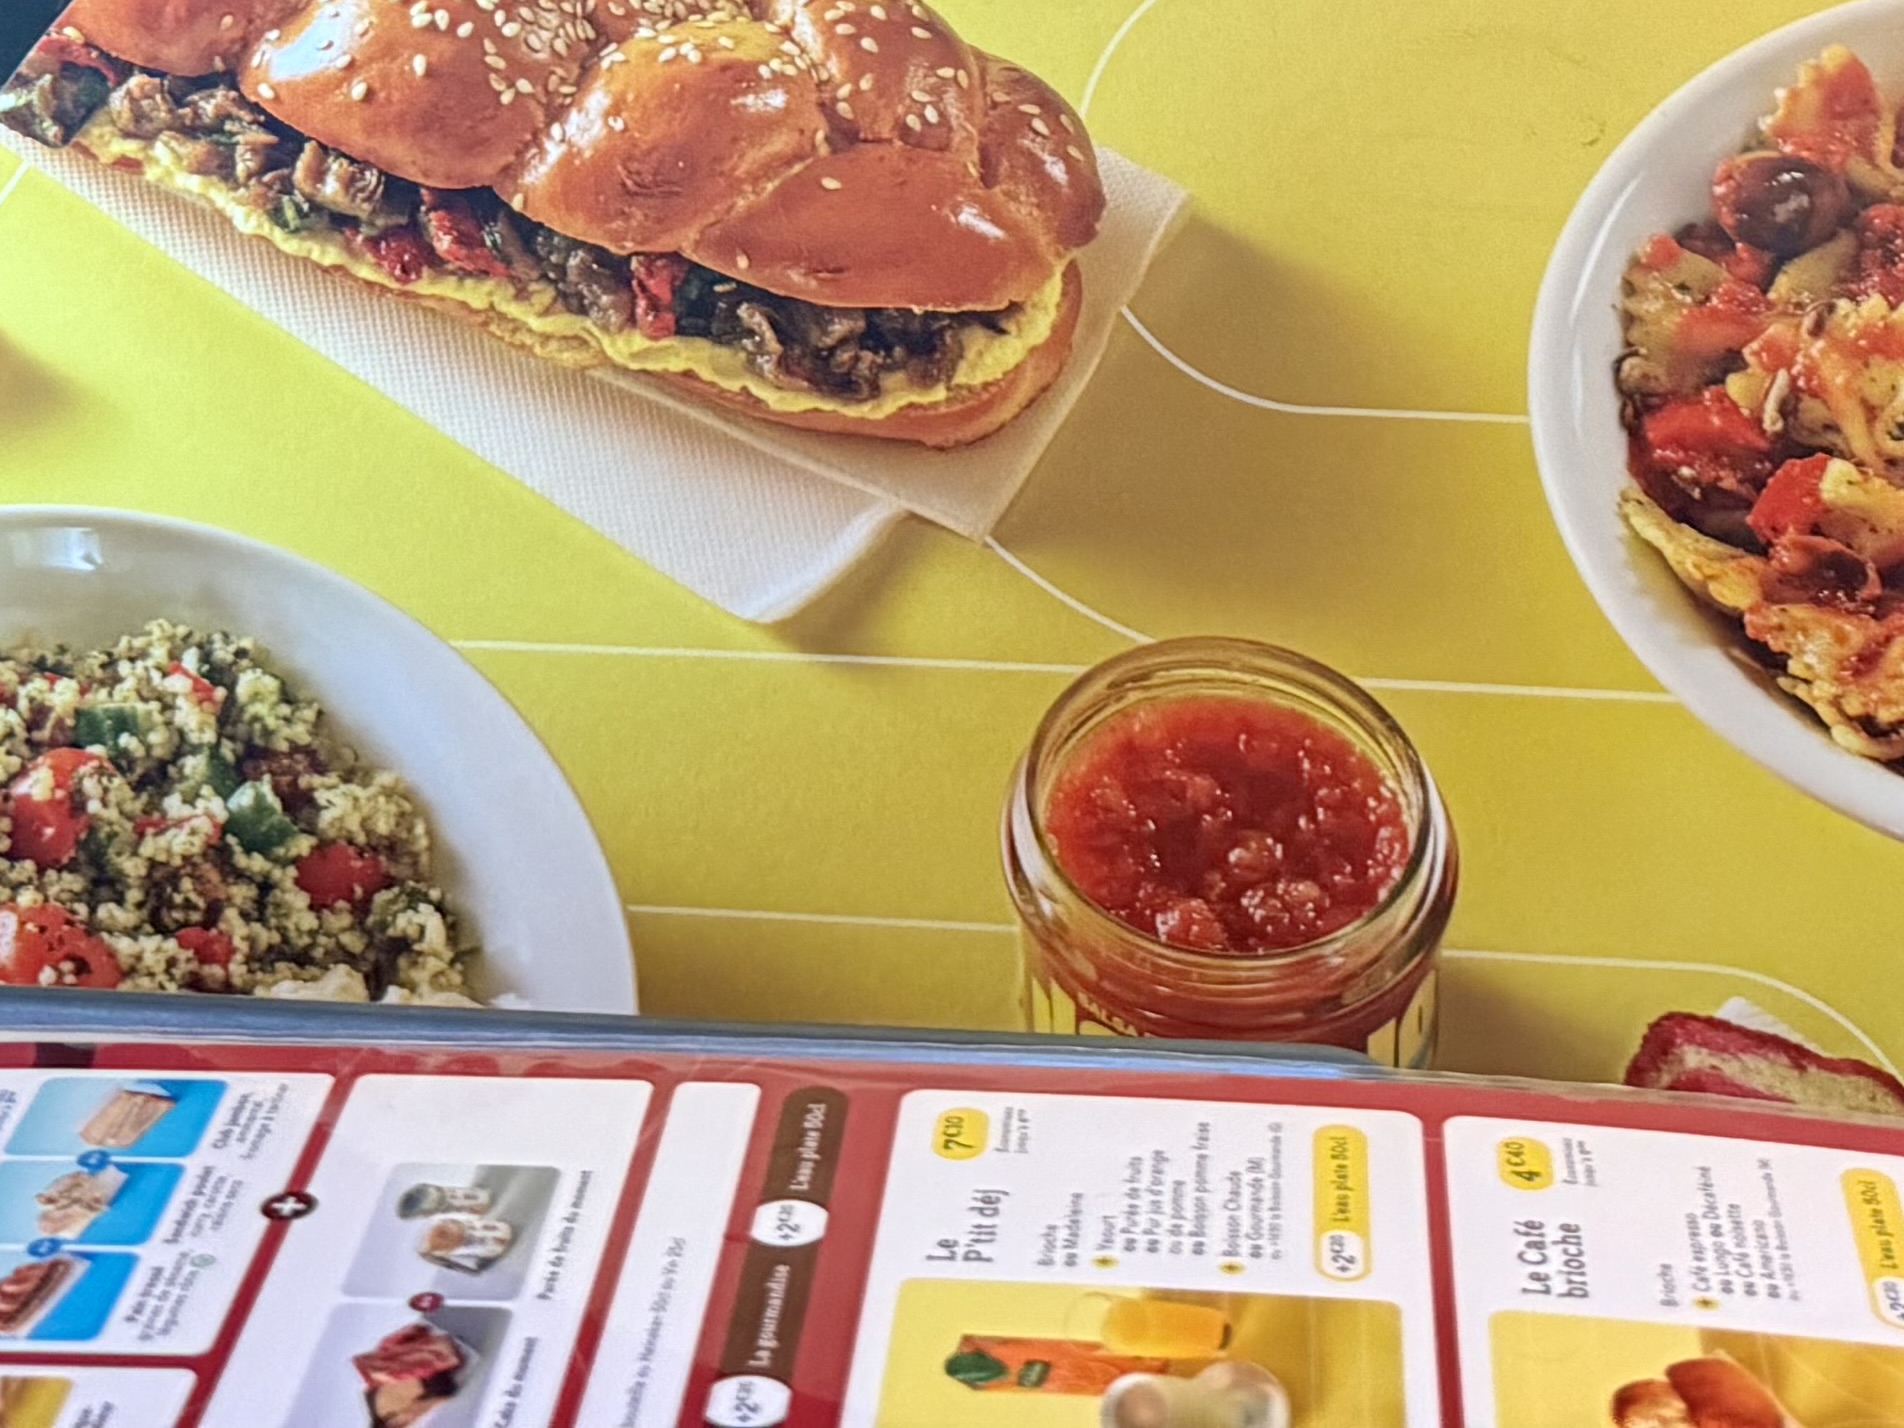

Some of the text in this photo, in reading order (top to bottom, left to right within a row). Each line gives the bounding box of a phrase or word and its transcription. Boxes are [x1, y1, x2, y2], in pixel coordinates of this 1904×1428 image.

[925, 1237, 959, 1263] Le
[962, 1188, 1010, 1264] P'tit déj
[1512, 1219, 1553, 1296] Le Café
[1551, 1222, 1590, 1300] brioche
